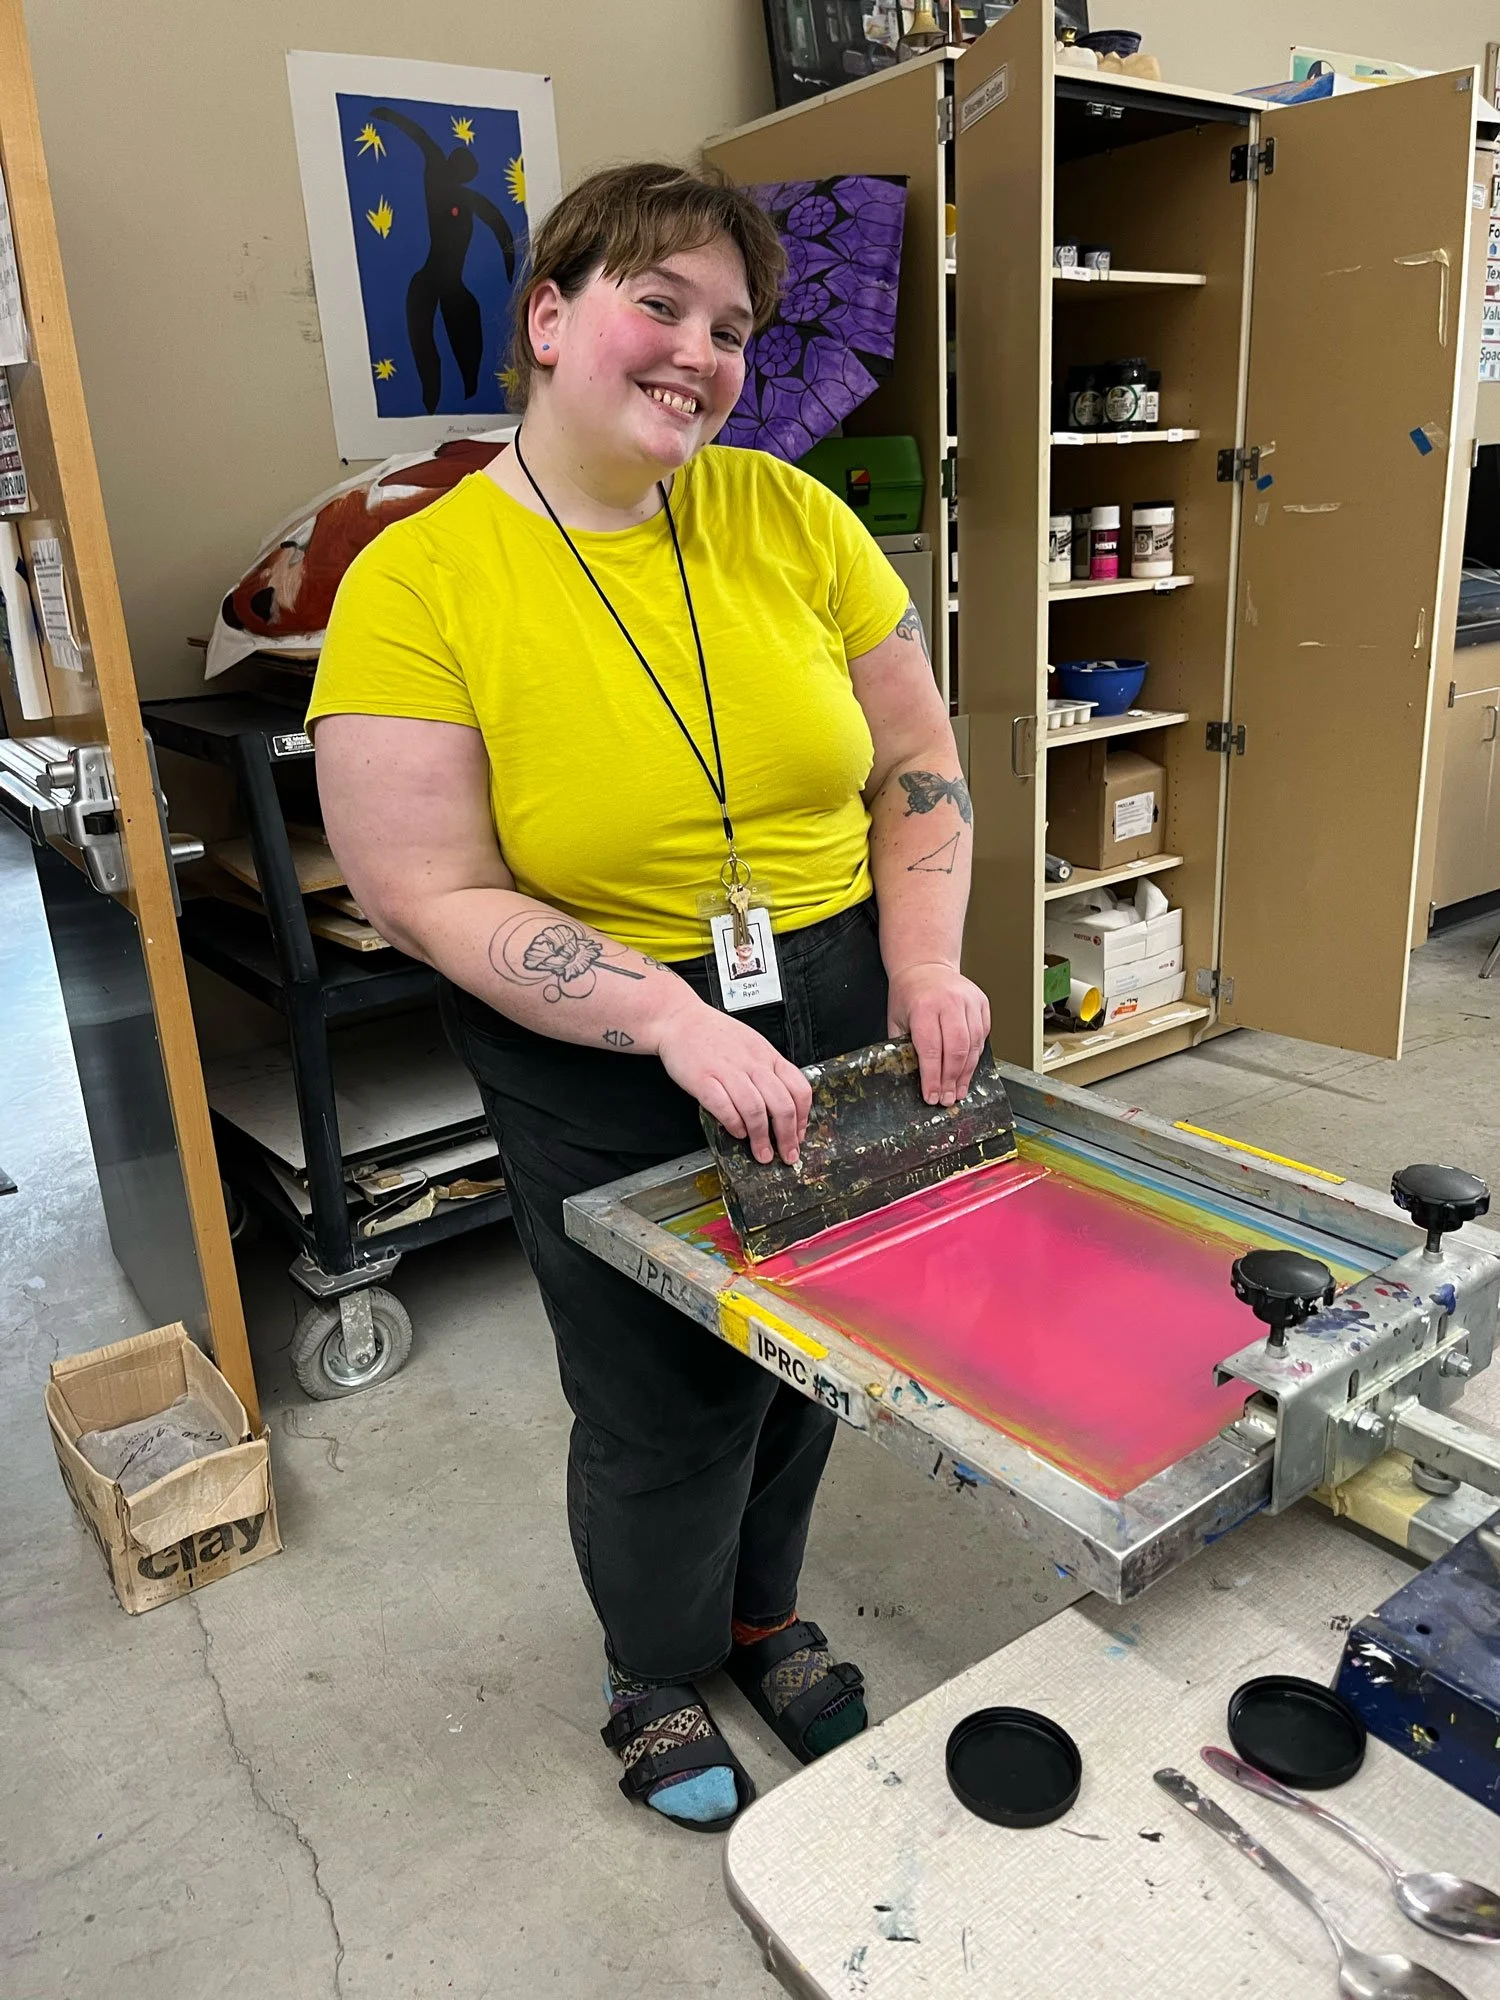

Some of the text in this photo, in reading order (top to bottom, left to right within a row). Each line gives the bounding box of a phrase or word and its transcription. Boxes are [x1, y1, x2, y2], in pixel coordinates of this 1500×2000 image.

[742, 982, 759, 990] Savi
[742, 989, 760, 998] Ryan
[757, 1332, 851, 1416] IPRC #31
[137, 1510, 267, 1580] clay
